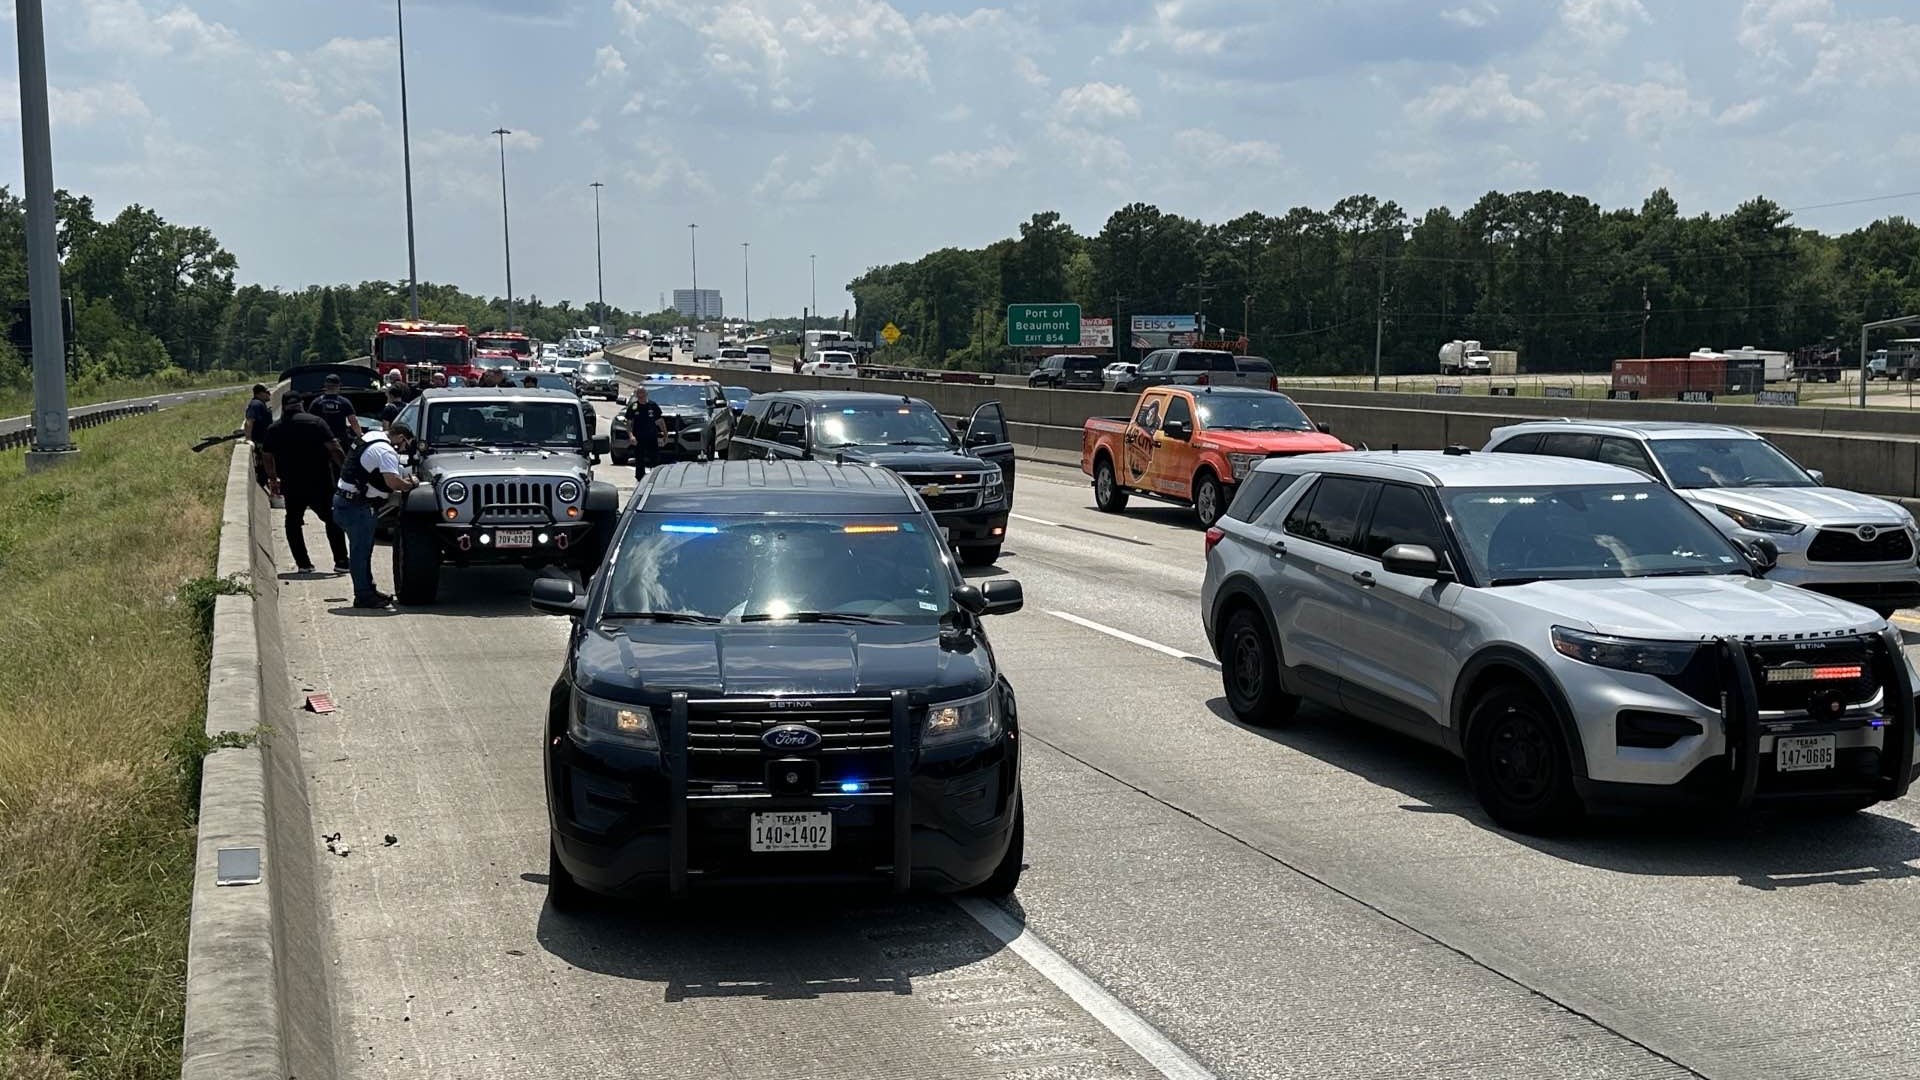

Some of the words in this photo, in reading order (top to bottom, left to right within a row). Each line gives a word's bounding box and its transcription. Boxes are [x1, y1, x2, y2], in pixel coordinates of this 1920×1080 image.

[1025, 309, 1047, 318] Port
[1052, 309, 1063, 318] of
[1015, 321, 1070, 330] Beaumont
[1080, 318, 1109, 326] EWARD
[1046, 334, 1064, 342] 854
[1794, 642, 1827, 650] SETINA
[769, 701, 813, 709] SETINA
[775, 731, 808, 745] Ford
[1796, 738, 1818, 746] TEXAS
[776, 815, 807, 823] TEXAS
